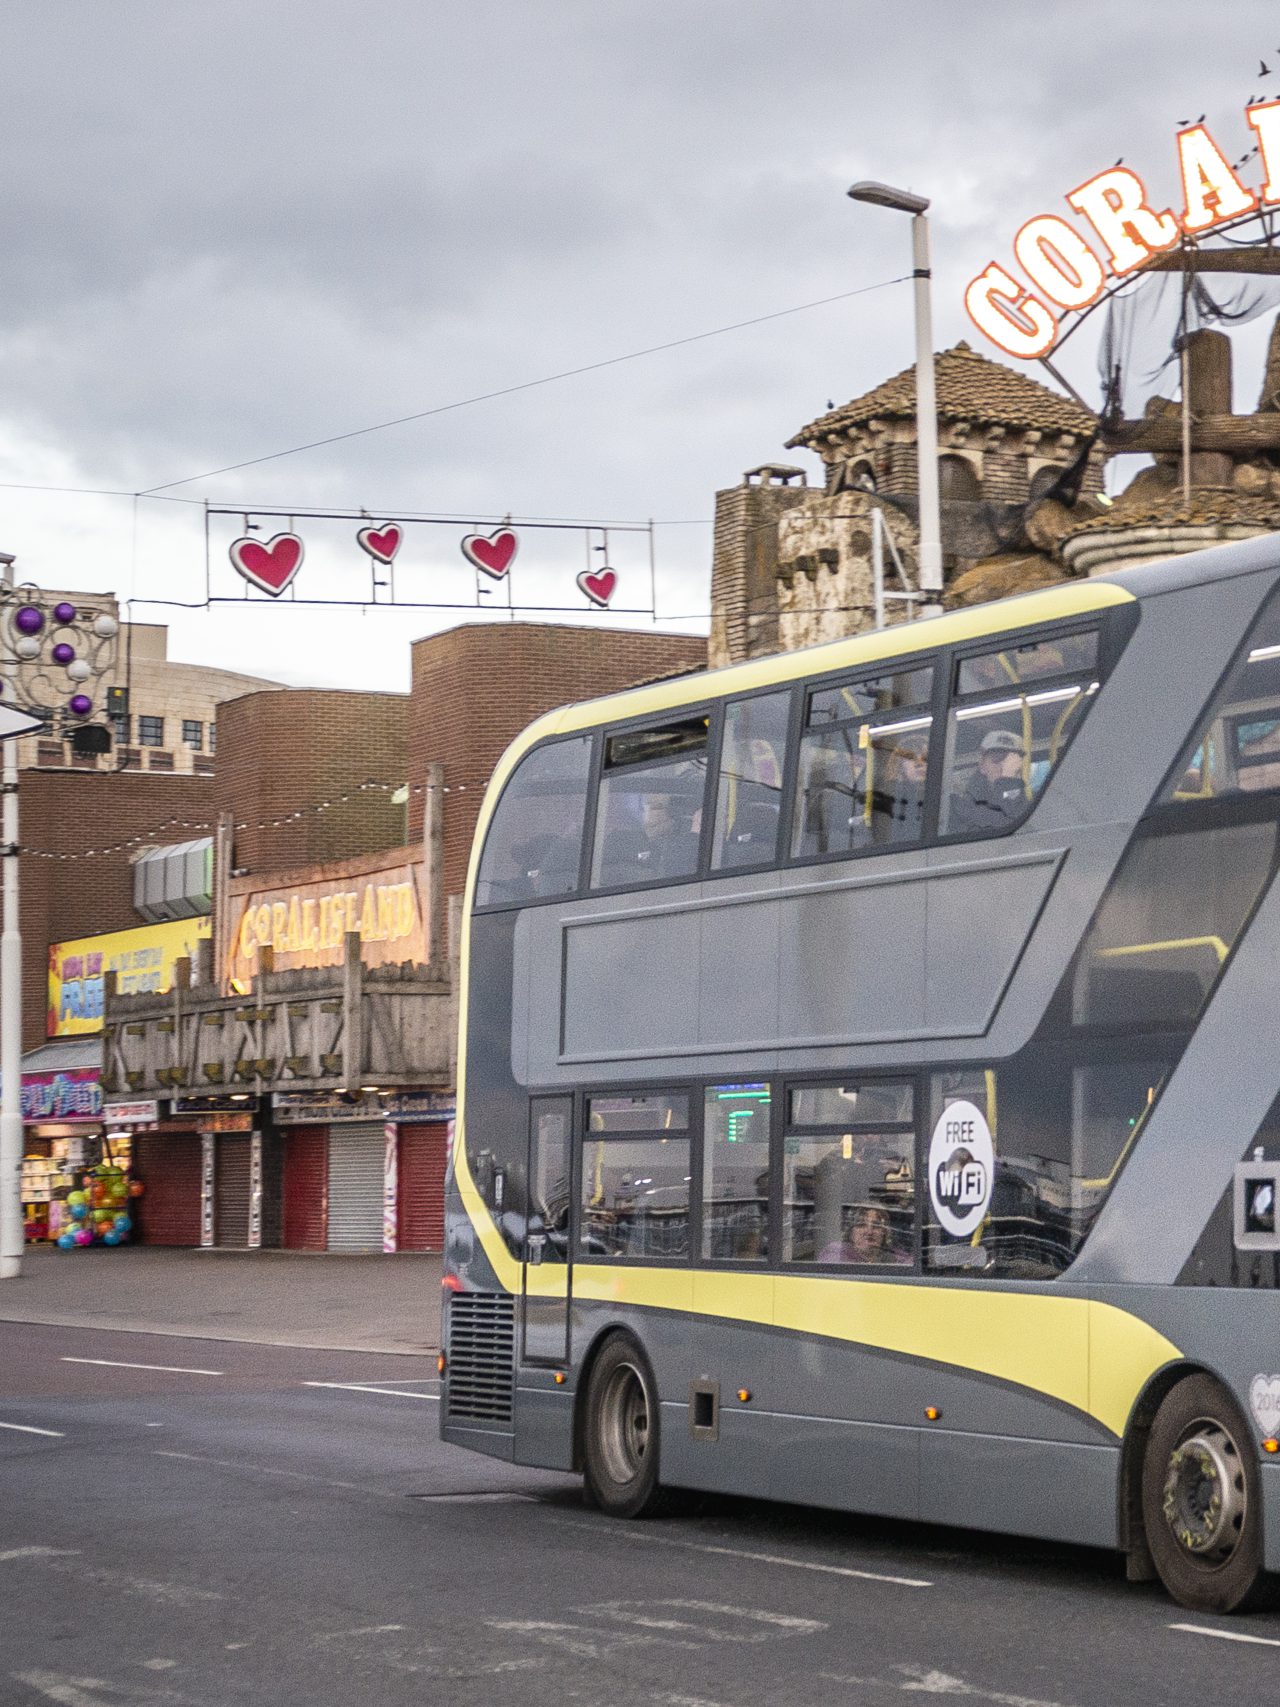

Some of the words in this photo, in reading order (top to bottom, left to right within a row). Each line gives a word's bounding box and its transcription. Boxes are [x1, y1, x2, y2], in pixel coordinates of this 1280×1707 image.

[240, 894, 318, 958] CORAL
[319, 882, 415, 949] ISLAND
[946, 1121, 975, 1143] FREE
